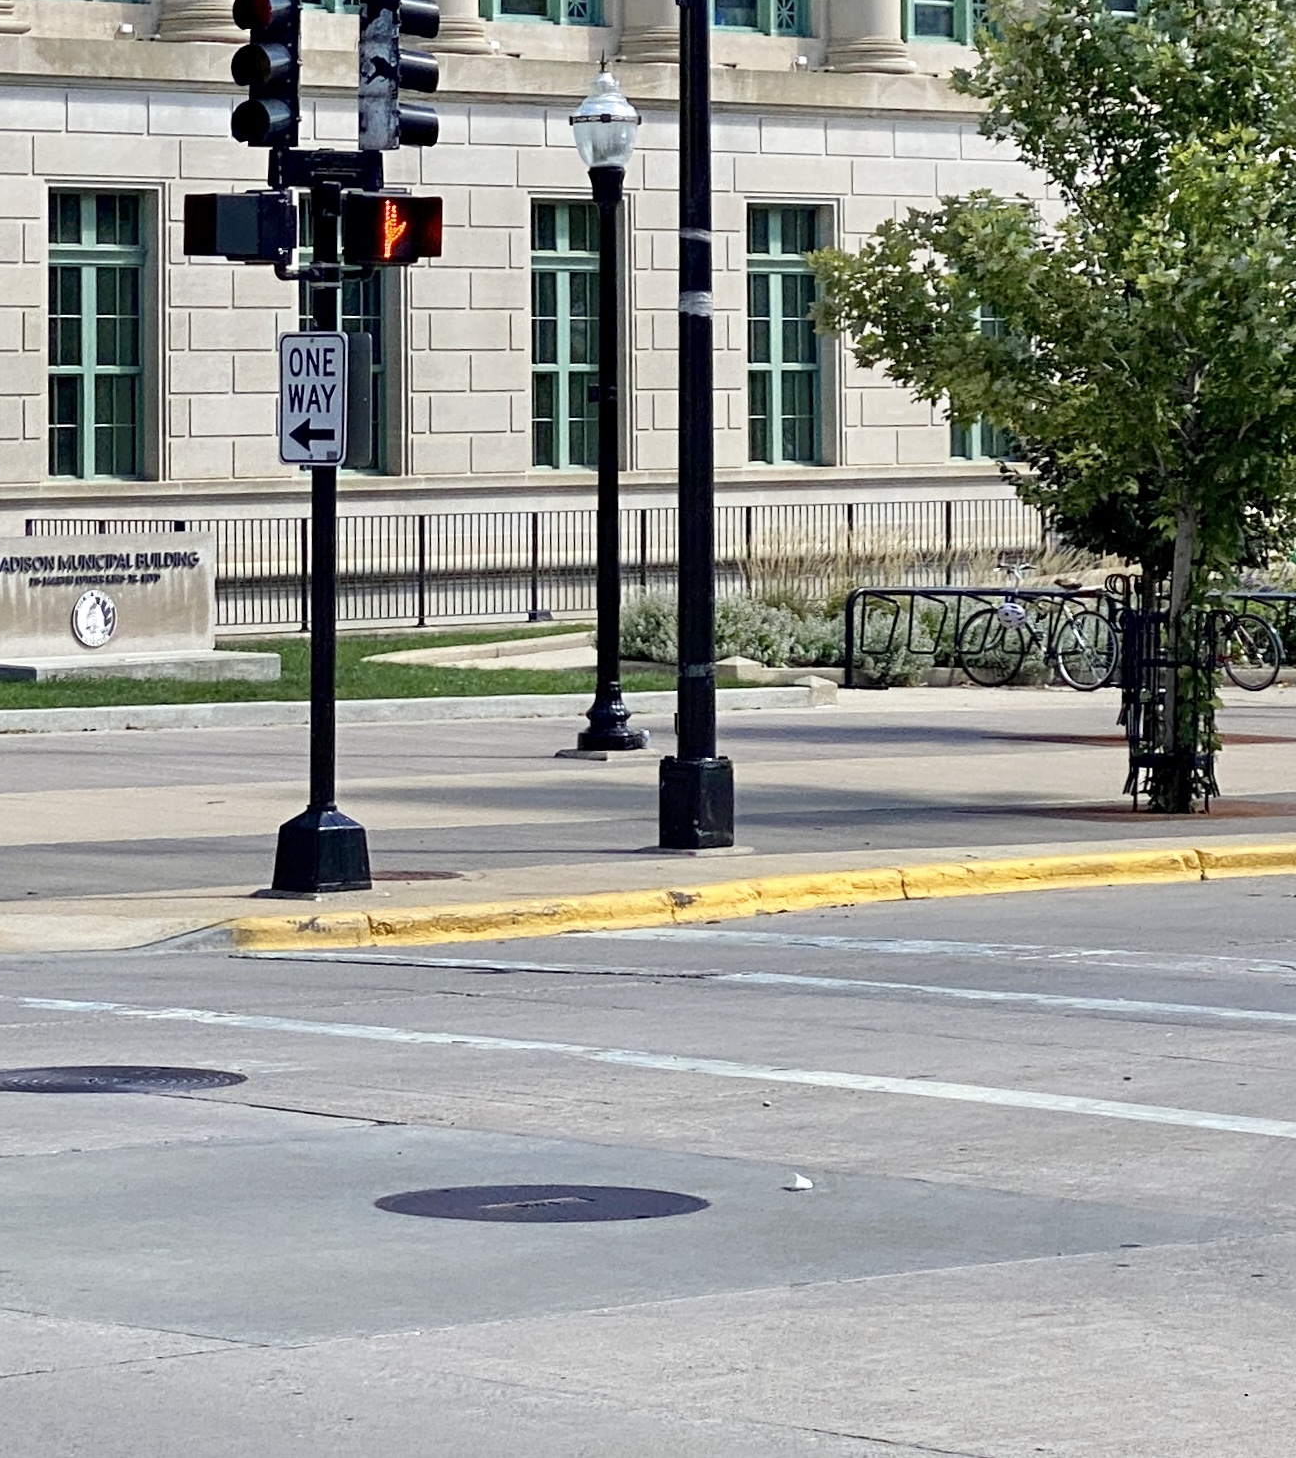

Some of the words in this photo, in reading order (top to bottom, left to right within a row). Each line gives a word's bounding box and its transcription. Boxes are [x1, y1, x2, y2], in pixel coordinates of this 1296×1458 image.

[289, 347, 336, 377] ONE
[288, 384, 337, 413] WAY
[57, 553, 134, 571] MUNICIPAL
[135, 551, 200, 568] BUILDING
